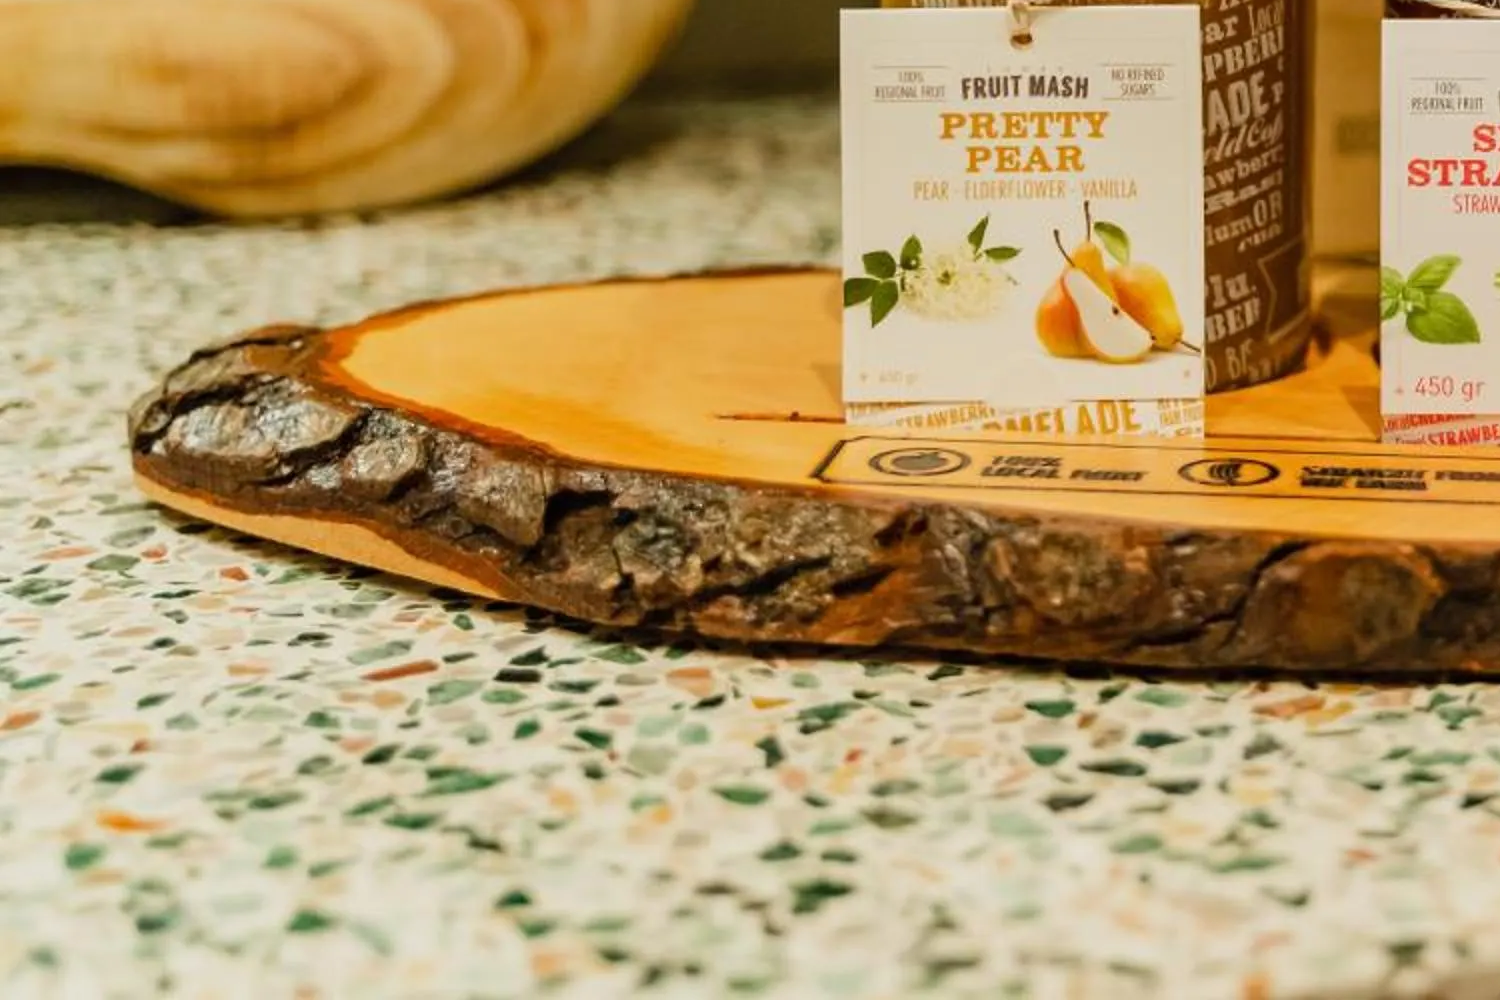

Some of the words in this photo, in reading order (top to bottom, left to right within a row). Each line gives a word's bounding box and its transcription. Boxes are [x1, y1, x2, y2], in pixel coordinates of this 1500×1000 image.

[961, 74, 1021, 99] FRUIT
[1029, 74, 1089, 98] MASH
[939, 111, 1110, 139] PRETTY
[965, 145, 1086, 174] PEAR
[913, 181, 950, 200] PEAR
[964, 179, 1066, 200] ELDERFLOWER
[1081, 179, 1138, 199] VANILLA
[1414, 375, 1455, 398] 450
[1461, 380, 1485, 401] gr
